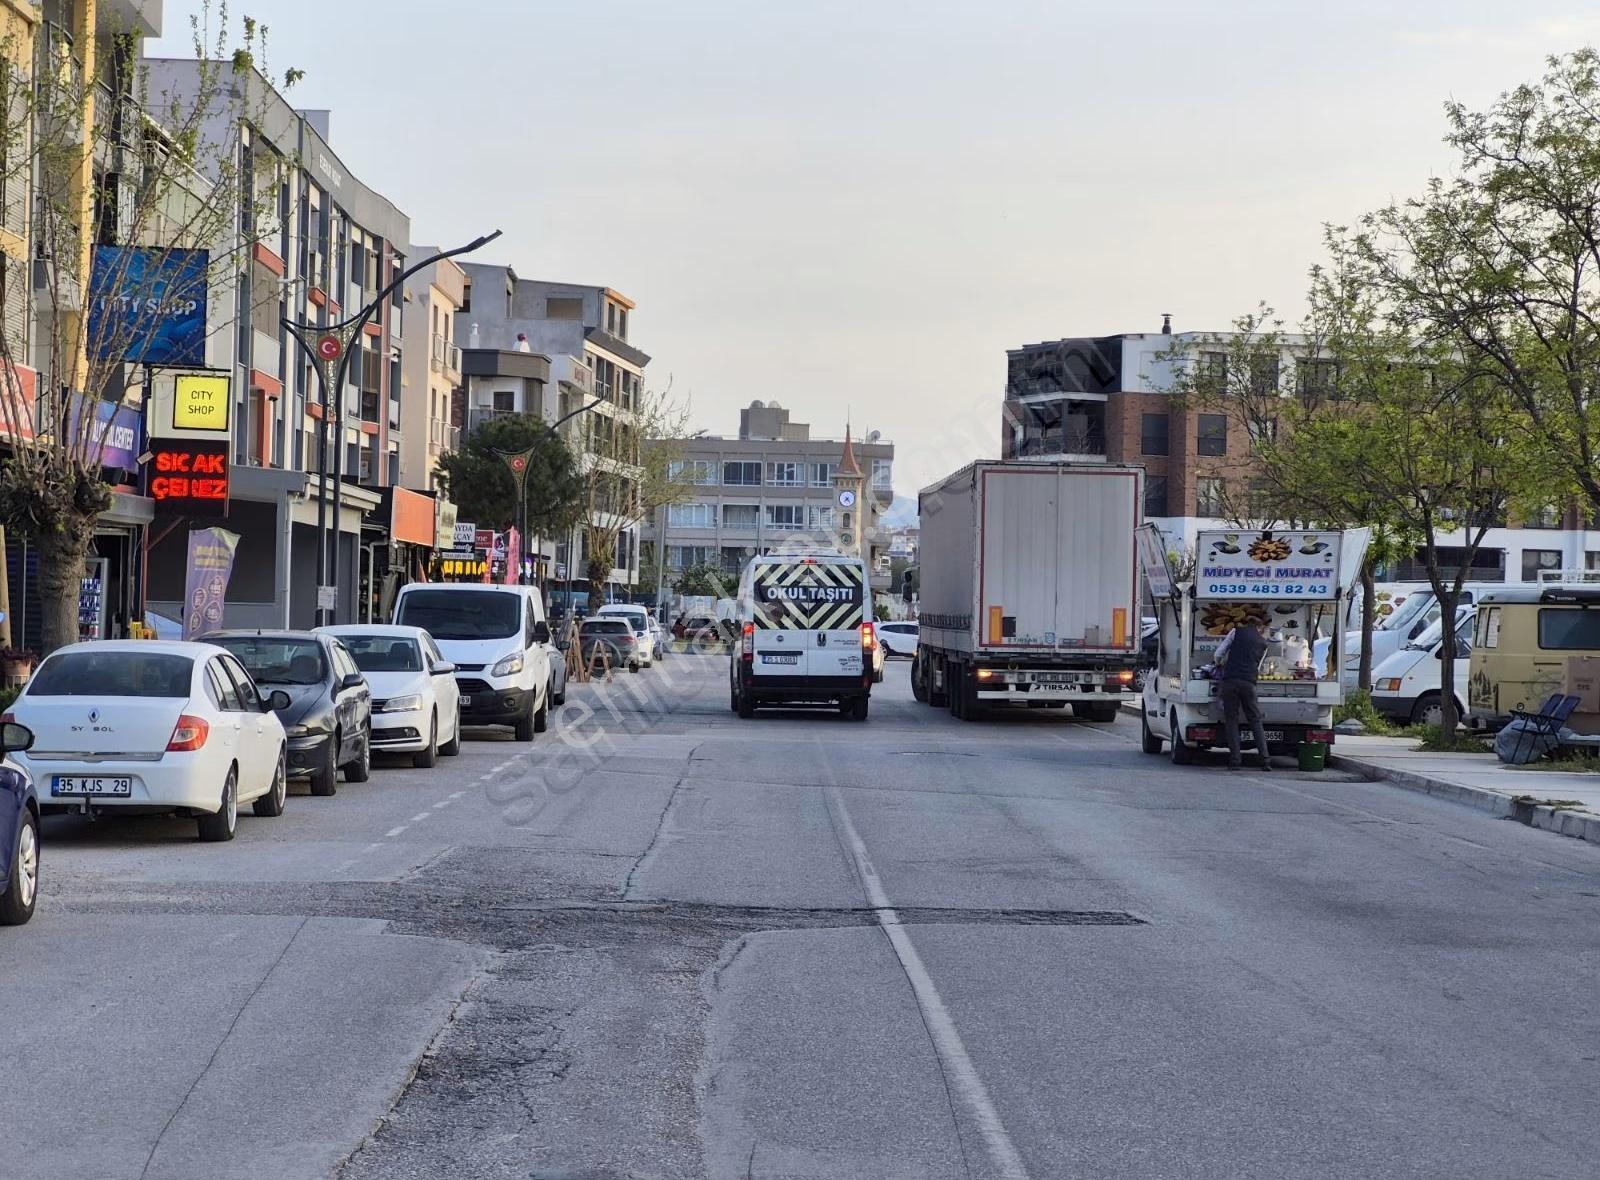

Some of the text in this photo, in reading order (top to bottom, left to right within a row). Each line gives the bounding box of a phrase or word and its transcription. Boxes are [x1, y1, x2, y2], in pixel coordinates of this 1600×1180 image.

[191, 390, 213, 400] CITY
[188, 405, 215, 415] SHOP
[1275, 568, 1333, 578] MURAT
[767, 587, 806, 600] OKUL
[1209, 584, 1327, 594] 0539 483 82 43
[1043, 683, 1077, 691] TIRSAN
[60, 779, 73, 792] 35
[81, 779, 103, 792] KJS
[113, 780, 128, 792] 29
